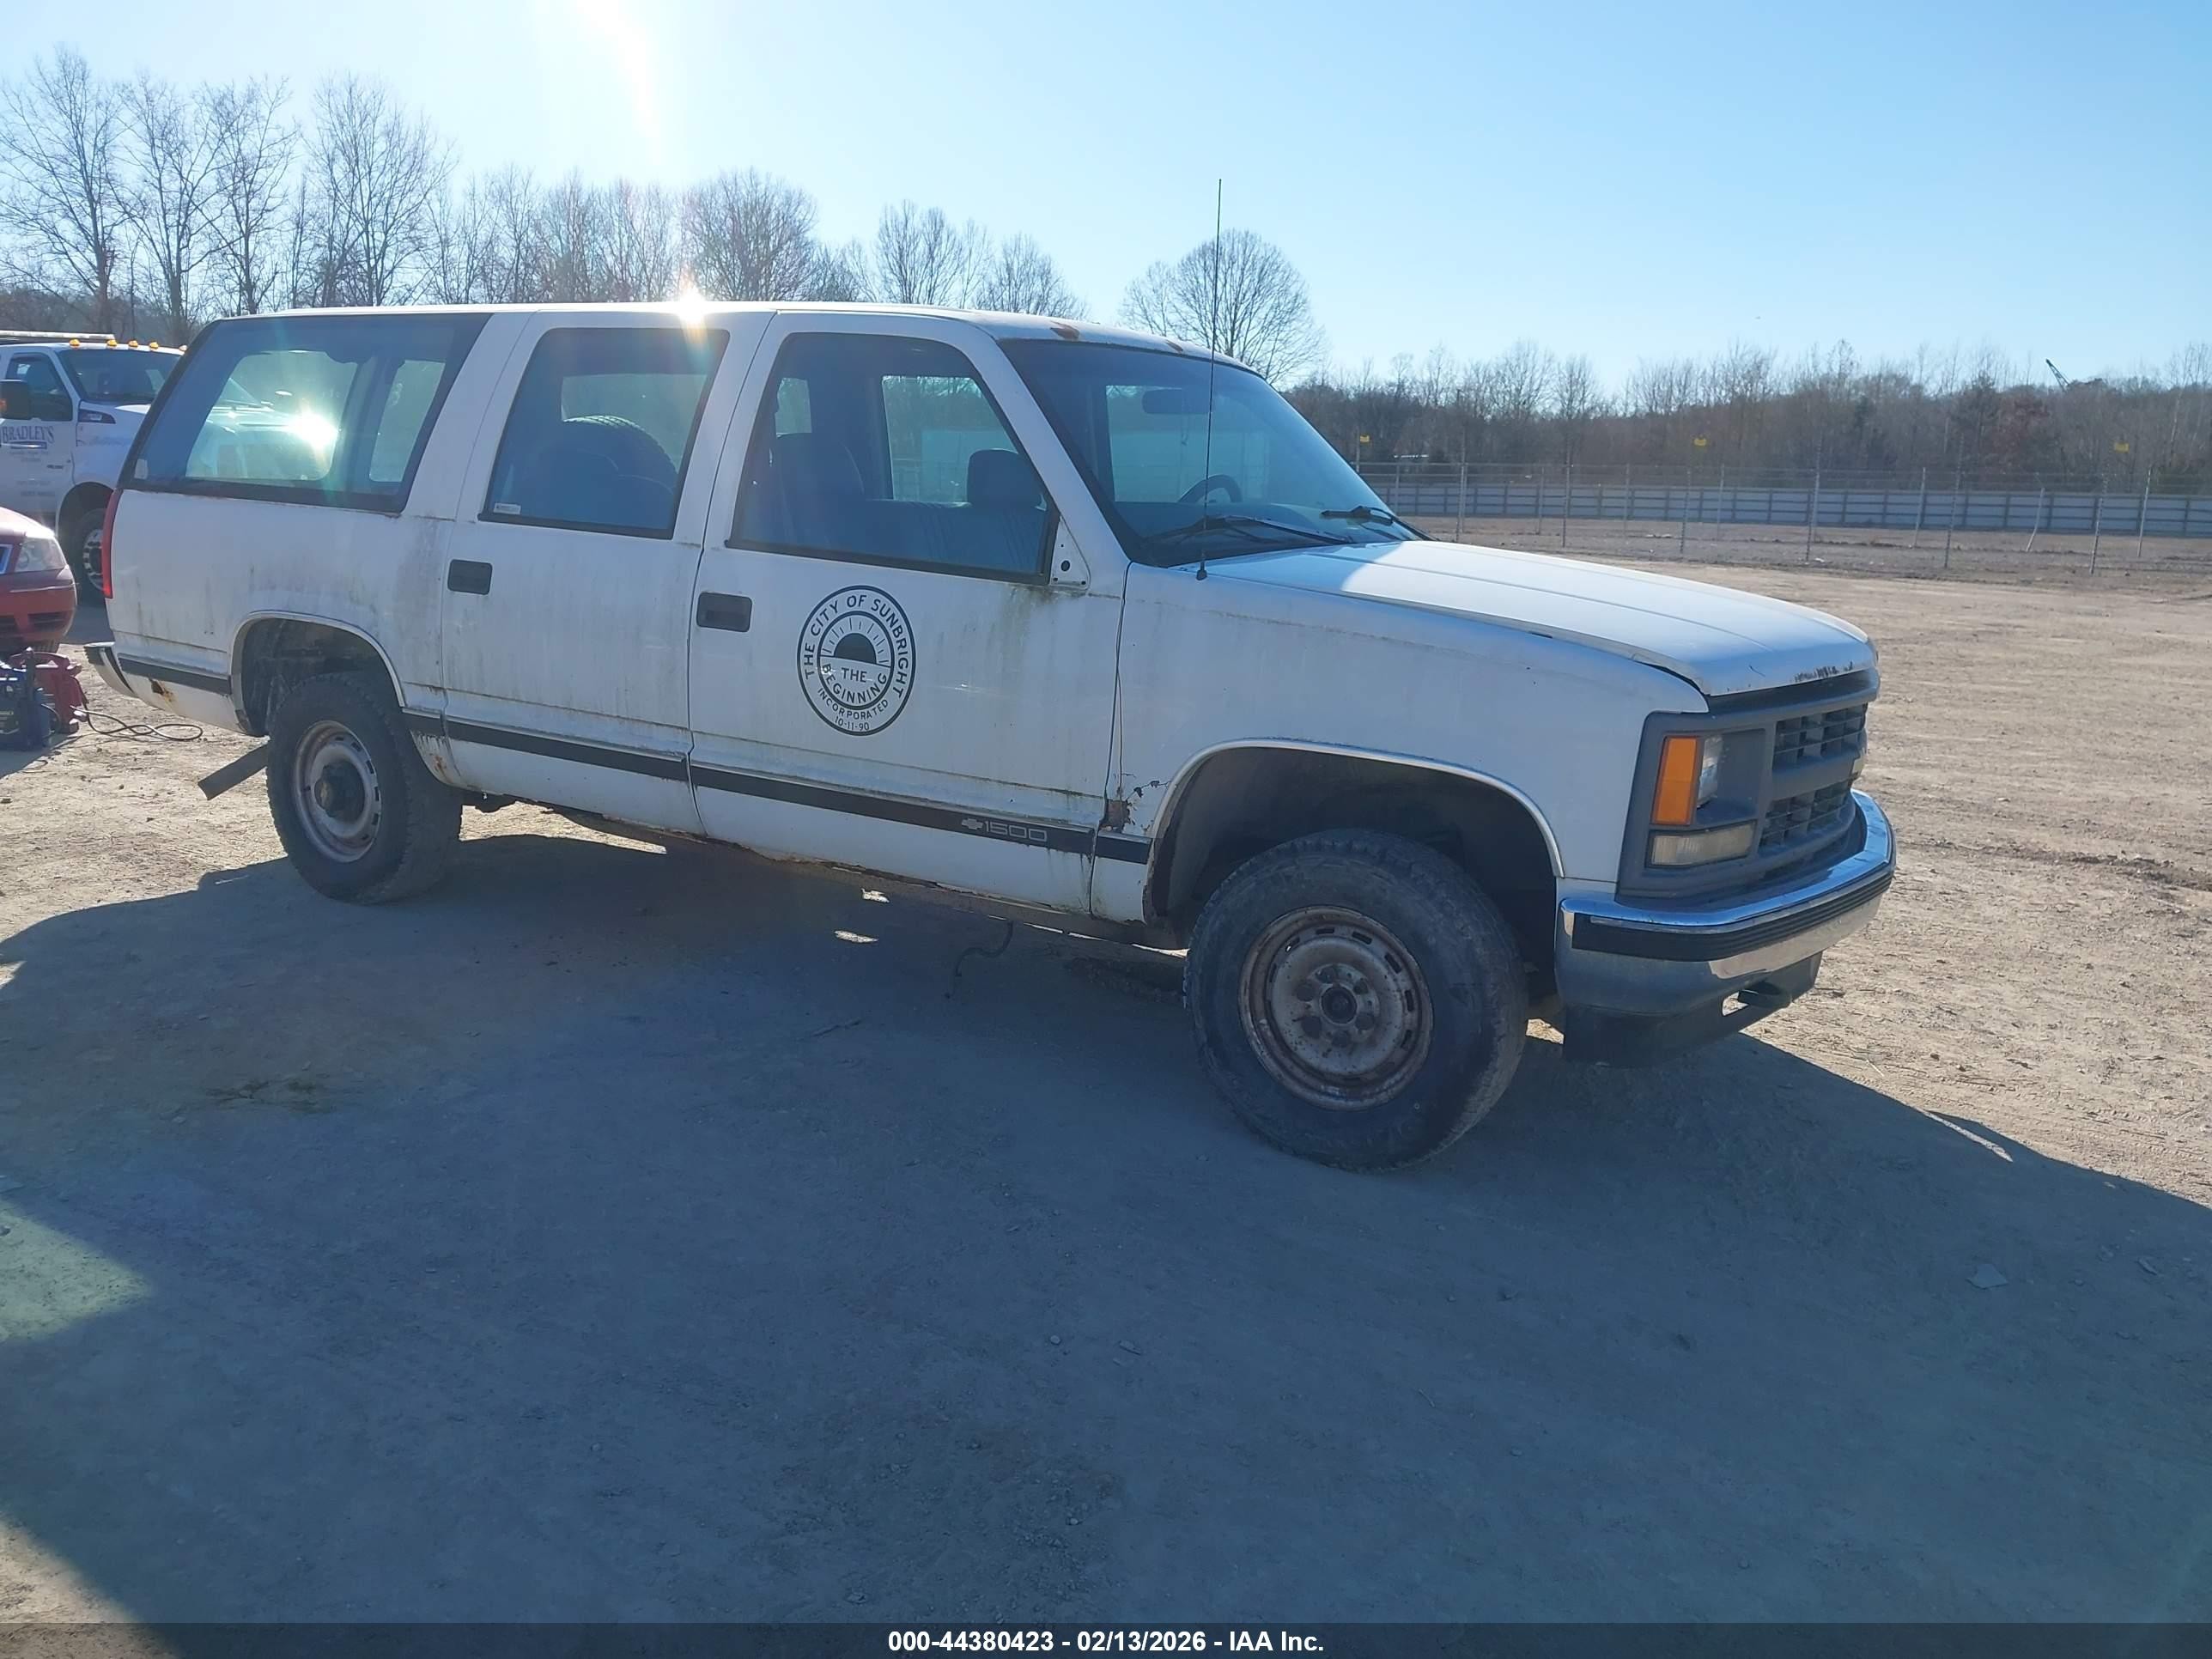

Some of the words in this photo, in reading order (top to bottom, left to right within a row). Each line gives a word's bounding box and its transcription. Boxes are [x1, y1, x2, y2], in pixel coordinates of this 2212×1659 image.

[3, 425, 55, 445] BRADLEY'S
[804, 642, 816, 680] THE
[810, 599, 839, 636] CITY
[846, 594, 867, 608] OF
[871, 599, 909, 699] SUNBRIGHT
[822, 663, 888, 704] BEGINNING
[841, 666, 868, 684] THE
[817, 687, 889, 720] INCORPORATED
[834, 715, 871, 732] 10-11-90
[983, 820, 1048, 842] 1500
